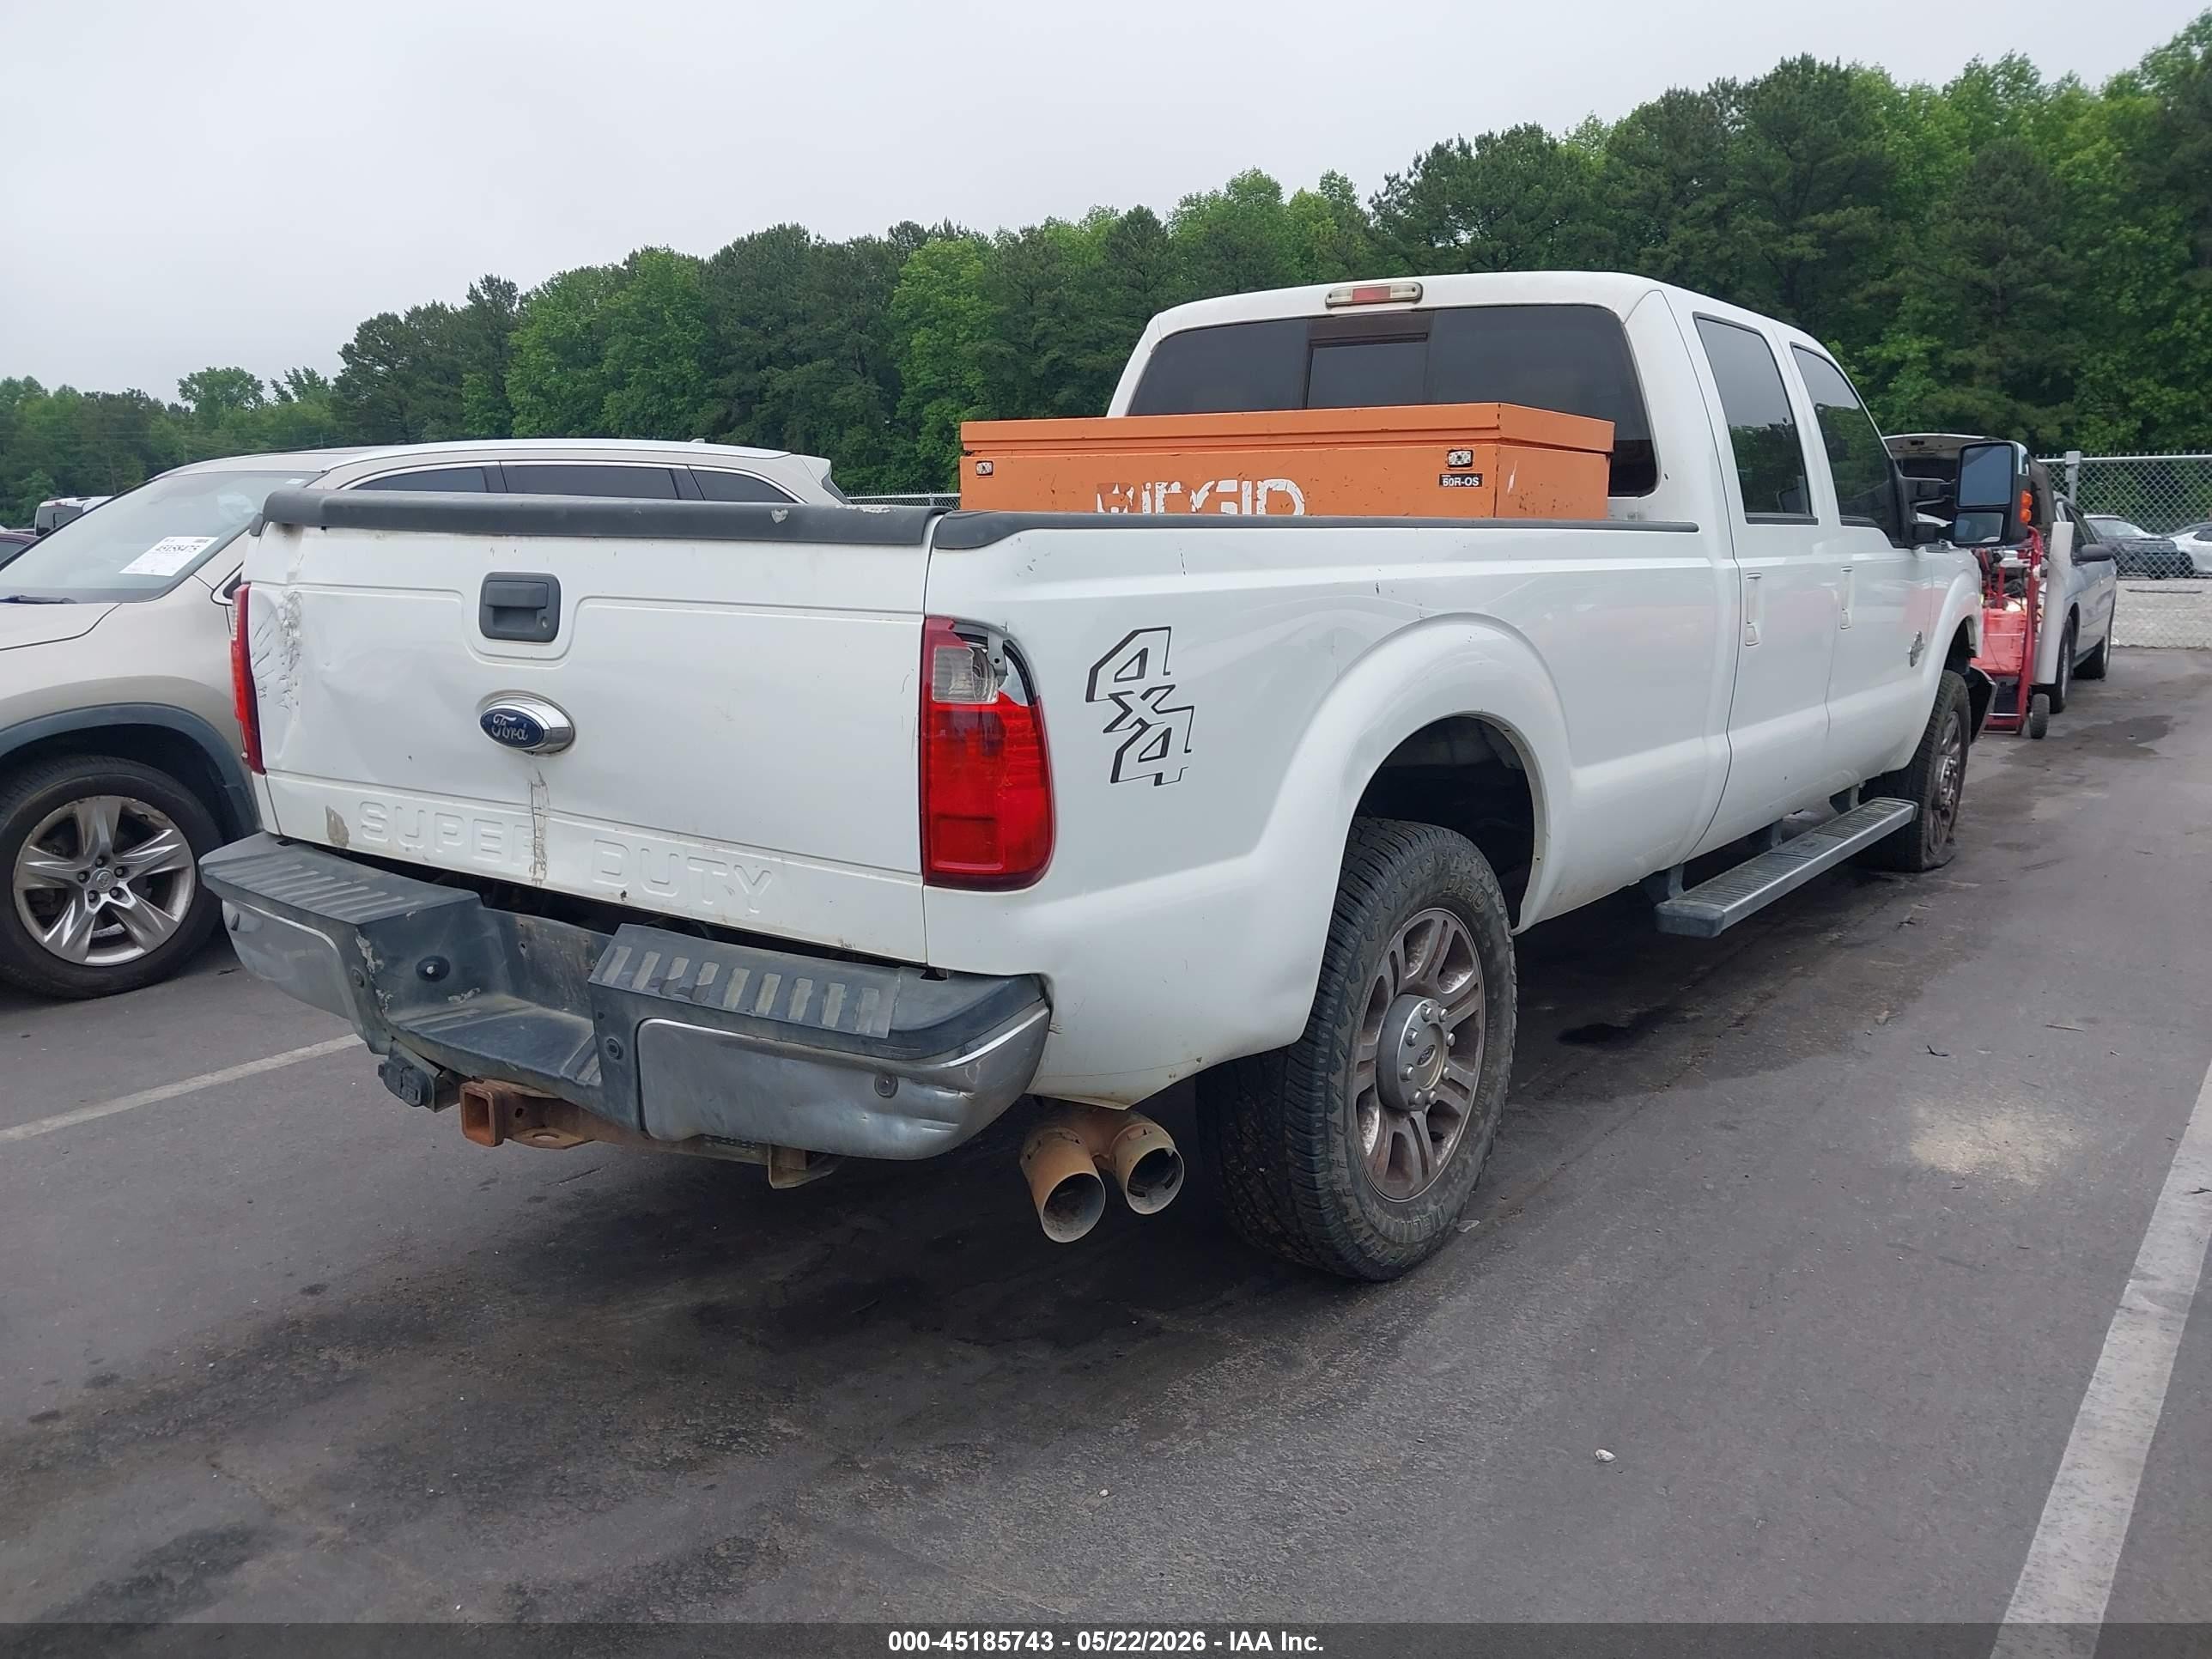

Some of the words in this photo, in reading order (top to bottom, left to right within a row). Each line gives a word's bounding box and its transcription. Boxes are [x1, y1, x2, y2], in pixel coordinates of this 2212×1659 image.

[491, 714, 529, 741] Ford
[358, 801, 548, 869] SUPER
[593, 838, 772, 914] DUTY
